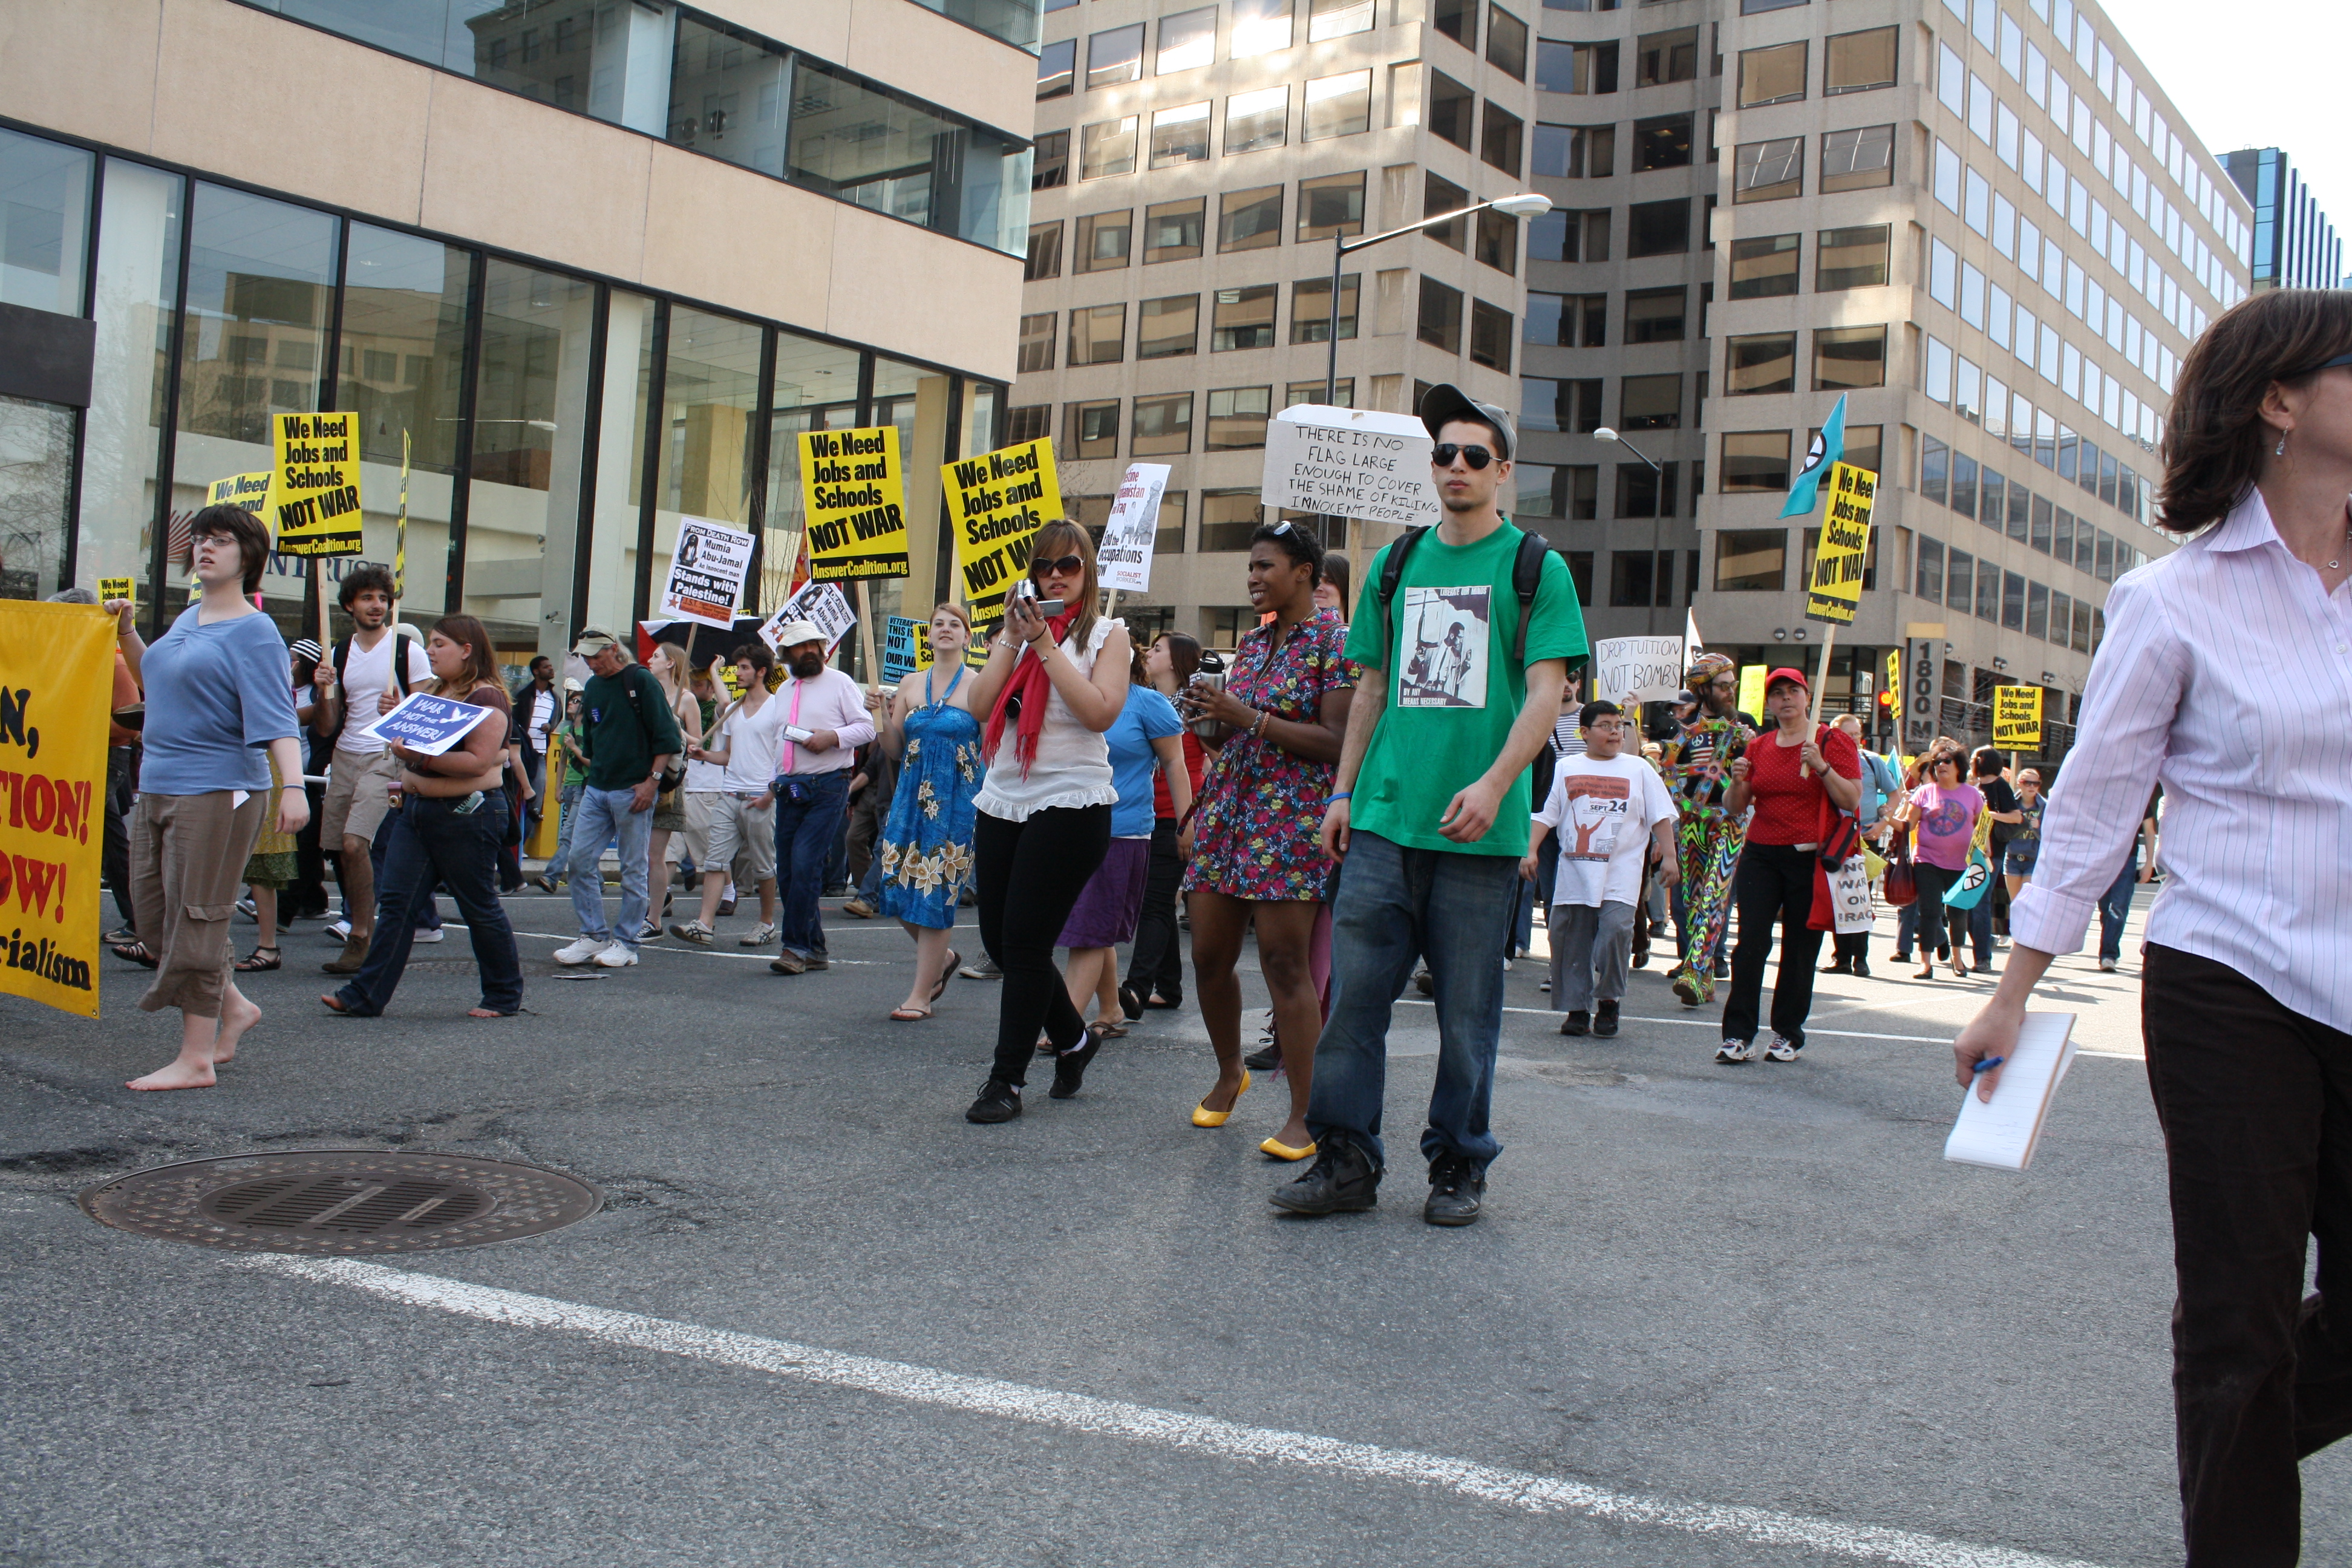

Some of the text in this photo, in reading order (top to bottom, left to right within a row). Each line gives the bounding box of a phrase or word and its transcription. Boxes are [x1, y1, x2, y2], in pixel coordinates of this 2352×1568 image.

[283, 416, 348, 439] We Need
[1296, 425, 1403, 450] THERE IS NO
[285, 440, 348, 463] Jobs and
[809, 430, 886, 459] We Need
[813, 456, 887, 484] Jobs and
[953, 444, 1039, 490] We Need
[1308, 446, 1397, 471] FLAG LARGE
[215, 474, 271, 500] We Need
[286, 465, 344, 489] Schools
[1295, 463, 1422, 496] ENOUGH TO COVER
[1838, 466, 1852, 492] We
[814, 483, 883, 509] Schools
[962, 472, 1044, 518] Jobs and
[1289, 479, 1439, 513] THE SHAME OF KILLING
[1291, 496, 1365, 517] INNOCENT
[278, 497, 316, 532] NOT
[317, 485, 361, 520] WAR
[1832, 493, 1855, 521] Jobs
[685, 524, 749, 547] FROM DEATH ROW
[808, 503, 905, 554] NOT WAR
[966, 505, 1042, 544] Schools
[1827, 520, 1863, 550] Schools
[278, 538, 362, 554] AnswerCoalition.org
[704, 539, 731, 554] Mumia
[701, 550, 743, 569] Abu-Jamal
[812, 560, 907, 579] AnswerCoalition.org
[963, 548, 1008, 594] NOT
[101, 578, 128, 589] We Need
[674, 569, 737, 594] Stands with
[1815, 557, 1839, 587] NOT
[102, 590, 116, 600] Jobs
[675, 582, 730, 605] Palestine!
[1440, 588, 1460, 596] LIBERATE
[1471, 587, 1487, 595] MINDS
[788, 605, 802, 621] Sta
[824, 599, 839, 622] Mumia
[841, 610, 851, 624] ROW
[971, 603, 1004, 622] Answe
[1807, 596, 1856, 621] AnswerCoalition.or
[816, 607, 838, 639] Abu-Jamal
[889, 625, 913, 638] THIS IS
[887, 637, 906, 650] NOT
[970, 632, 986, 649] NO
[1601, 640, 1681, 662] DROP TUITION
[886, 652, 903, 664] OUR
[967, 655, 987, 665] Answe
[1601, 662, 1681, 698] NOT BOMBS
[1914, 642, 1932, 714] 1800
[1403, 697, 1447, 705] MEANS NECESSARY
[2001, 687, 2035, 698] We Need
[414, 699, 446, 715] WAR
[1999, 709, 2031, 720] Schools
[2000, 699, 2034, 710] Jobs and
[404, 711, 422, 722] NOT
[387, 720, 445, 740] ANSWER!
[1995, 721, 2039, 738] NOT WAR
[1609, 800, 1627, 813] 24
[1838, 877, 1867, 889] WAR
[1847, 894, 1866, 905] ON
